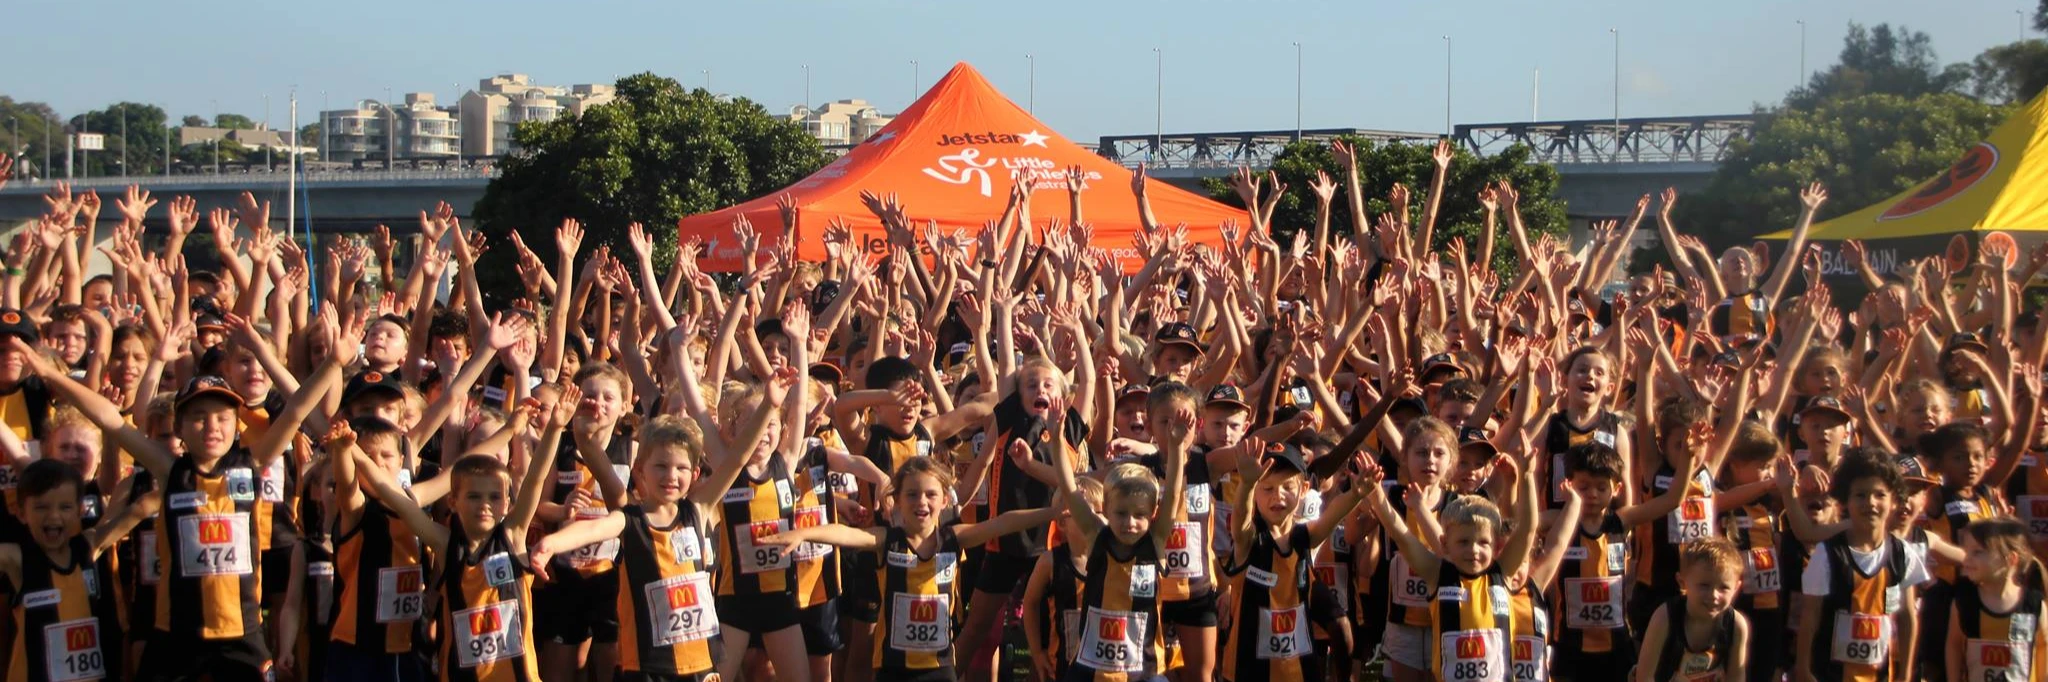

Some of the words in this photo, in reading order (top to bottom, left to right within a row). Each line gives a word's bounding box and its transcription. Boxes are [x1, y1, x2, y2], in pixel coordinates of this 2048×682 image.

[936, 131, 1021, 146] Jetstar
[1001, 156, 1055, 169] Little
[1821, 248, 1897, 275] BALAIN
[236, 481, 247, 495] 6
[785, 493, 791, 505] 6
[1679, 522, 1708, 538] 736
[196, 546, 238, 567] 474
[684, 544, 694, 558] 6
[755, 547, 780, 567] 95
[495, 566, 506, 580] 6
[944, 564, 951, 577] 6
[1141, 579, 1149, 592] 6
[392, 596, 420, 615] 163
[1579, 605, 1614, 621] 452
[669, 608, 704, 632] 297
[905, 624, 938, 642] 382
[470, 633, 507, 657] 931
[1095, 642, 1128, 661] 565
[1270, 633, 1296, 654] 921
[1847, 642, 1879, 660] 691
[65, 650, 101, 674] 180
[1454, 661, 1489, 680] 883
